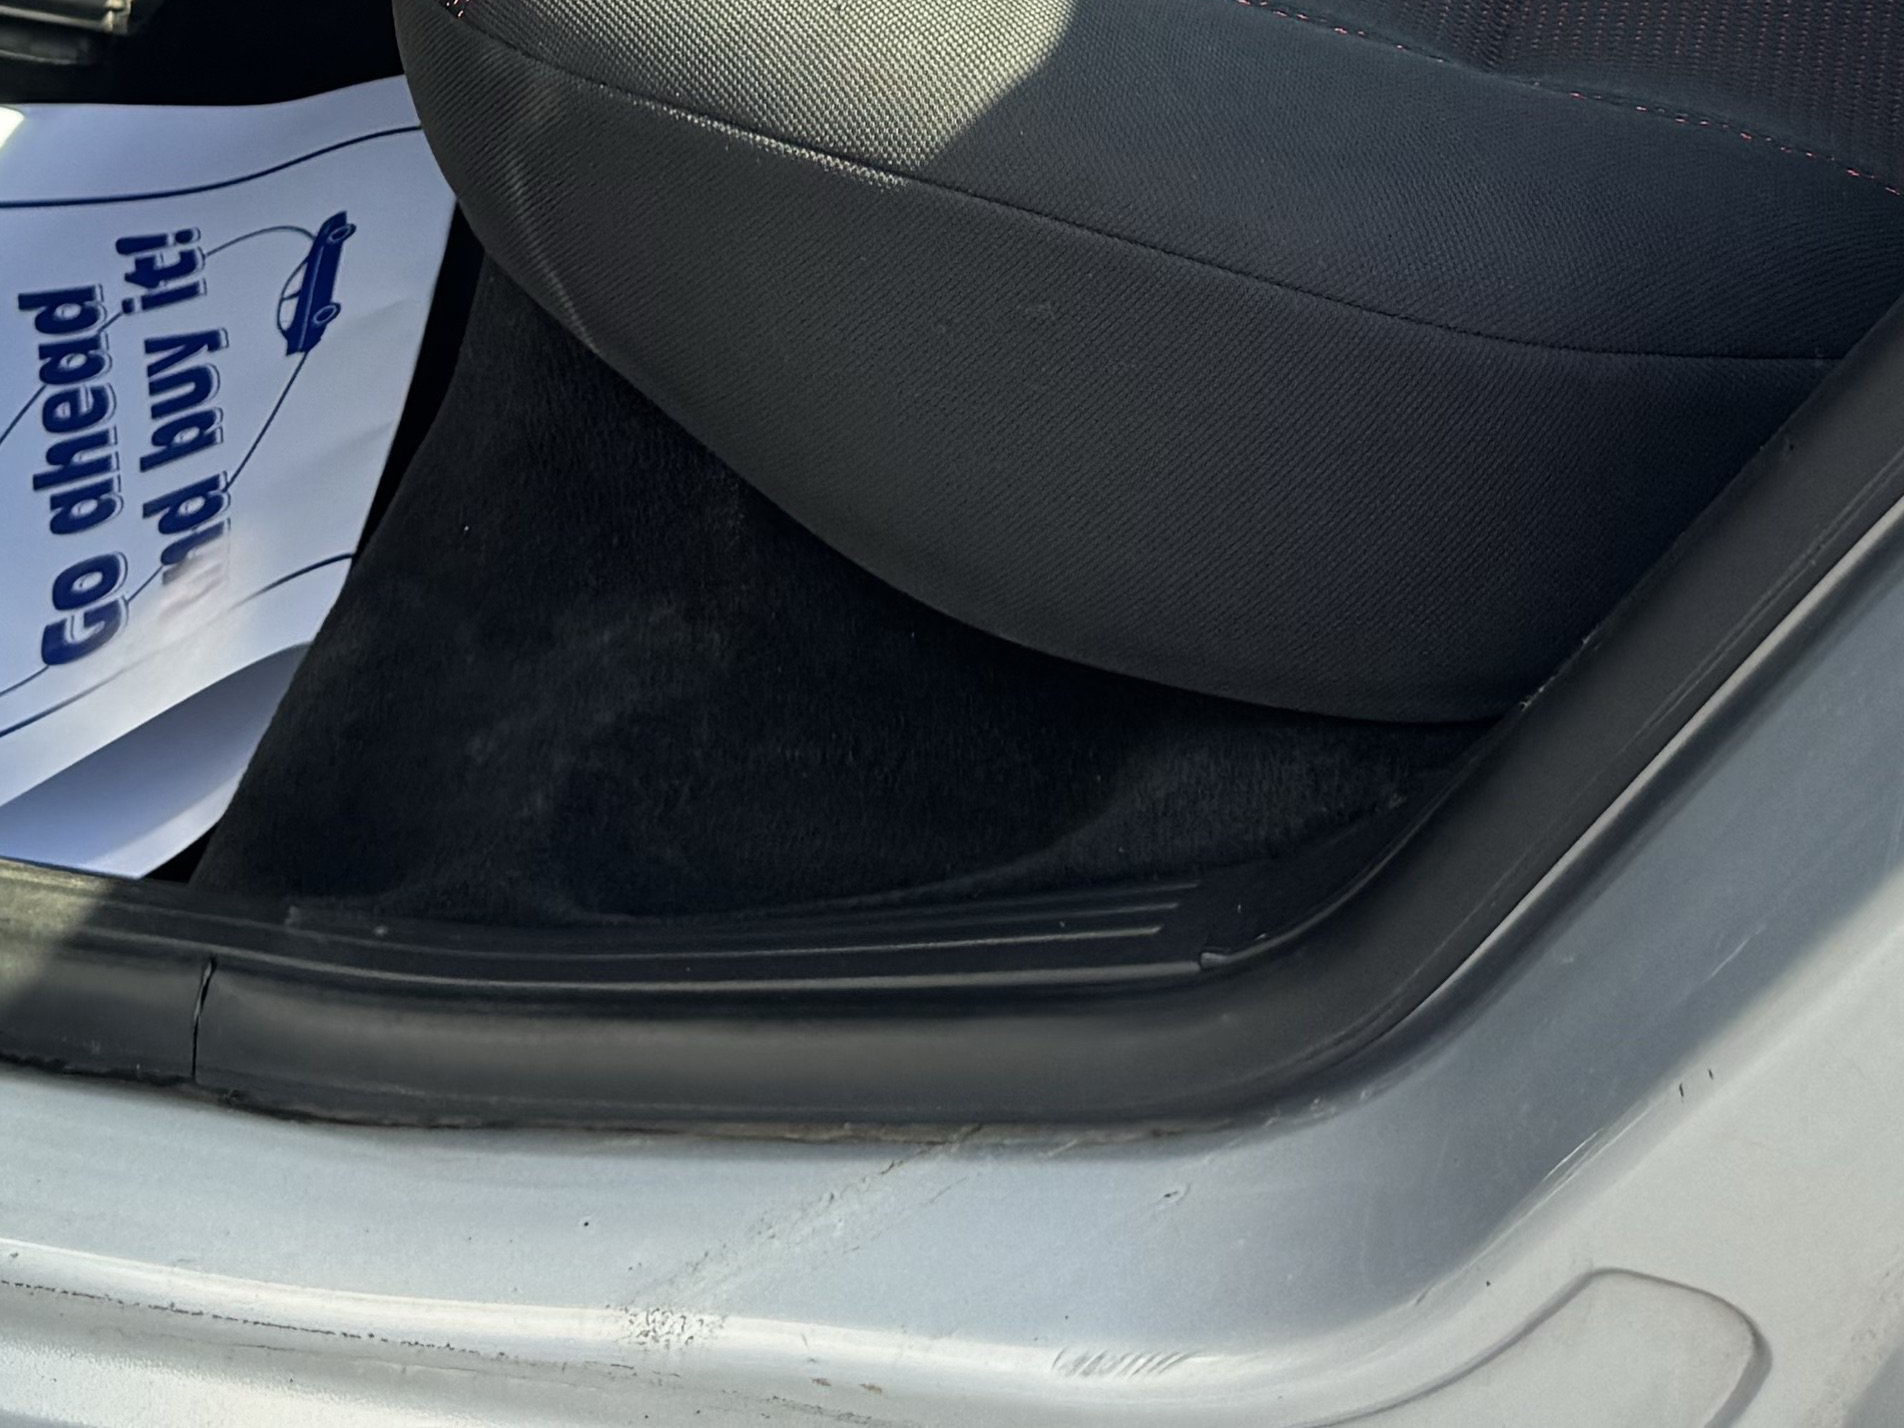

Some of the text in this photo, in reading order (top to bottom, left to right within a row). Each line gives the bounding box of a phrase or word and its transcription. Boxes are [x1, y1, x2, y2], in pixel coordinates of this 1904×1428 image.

[114, 227, 208, 315] it!
[139, 327, 229, 472] buy
[18, 284, 129, 665] Go ahead
